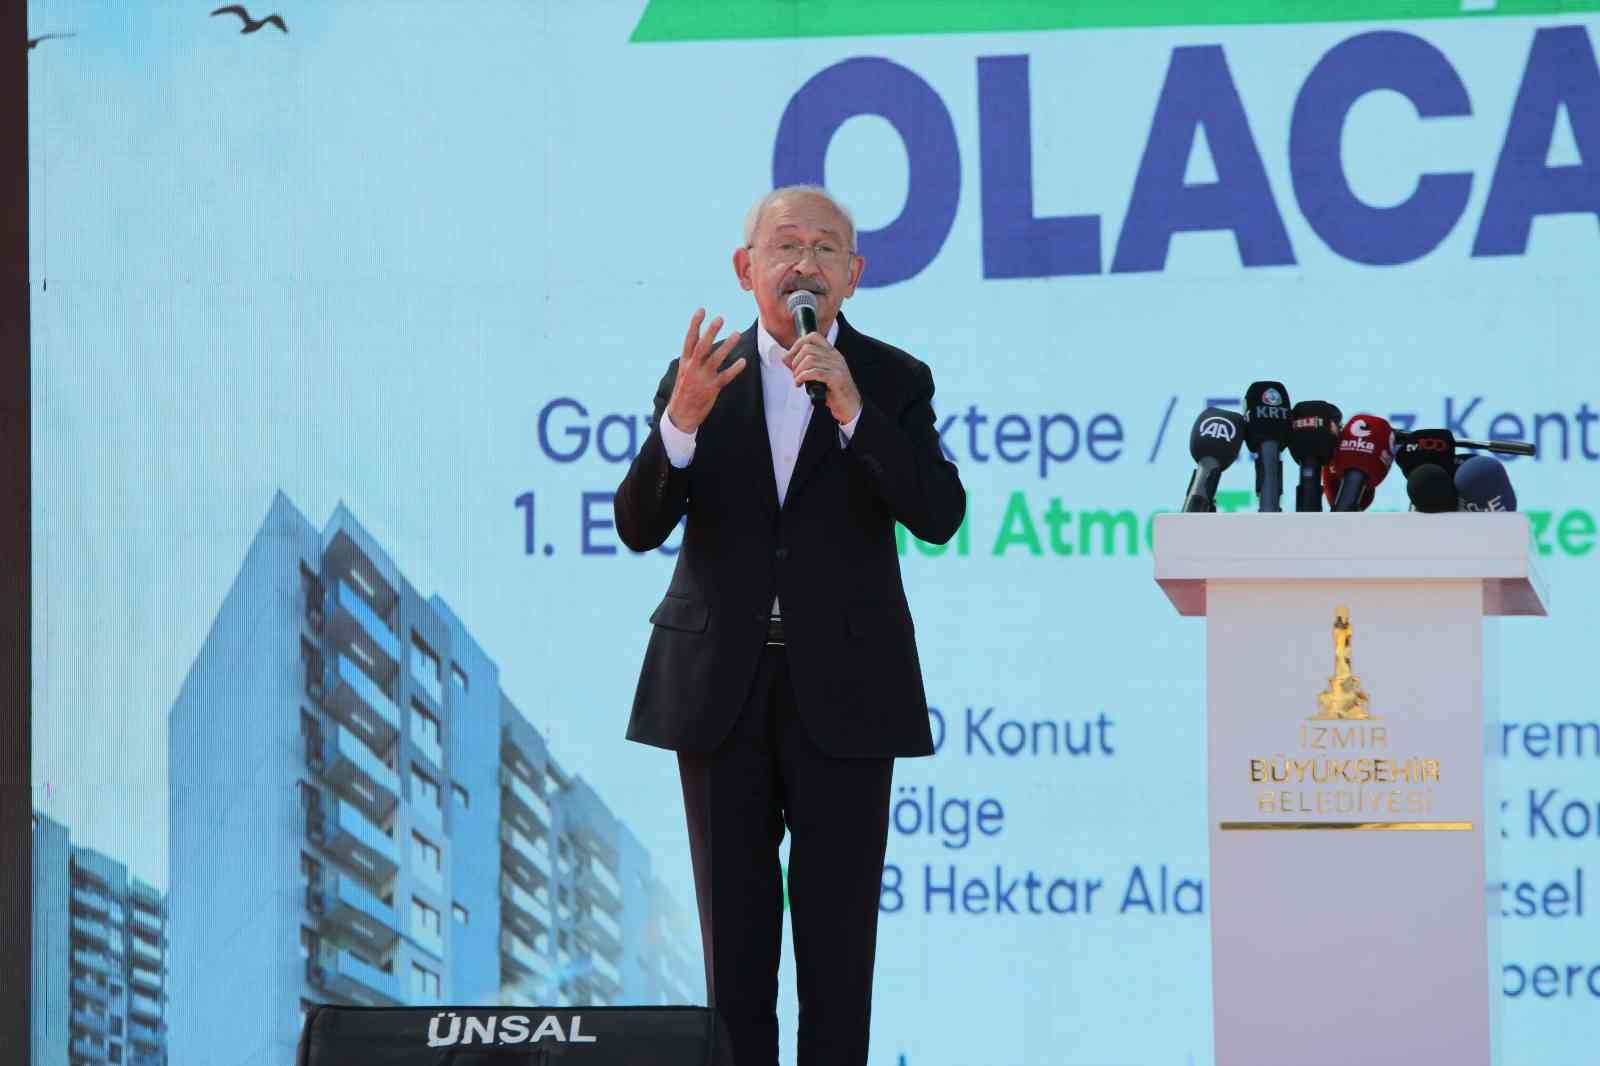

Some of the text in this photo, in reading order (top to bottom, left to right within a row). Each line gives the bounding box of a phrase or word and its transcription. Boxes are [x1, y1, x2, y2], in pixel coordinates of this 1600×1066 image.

[537, 397, 655, 464] Ga
[1256, 405, 1289, 419] KRT
[1341, 438, 1375, 450] anka
[514, 491, 554, 556] 1.
[991, 491, 1152, 557] Atm
[964, 706, 1115, 756] Konut
[893, 786, 1005, 849] ölge
[924, 864, 1103, 915] Hektar
[427, 1012, 597, 1047] ÜNSAL
